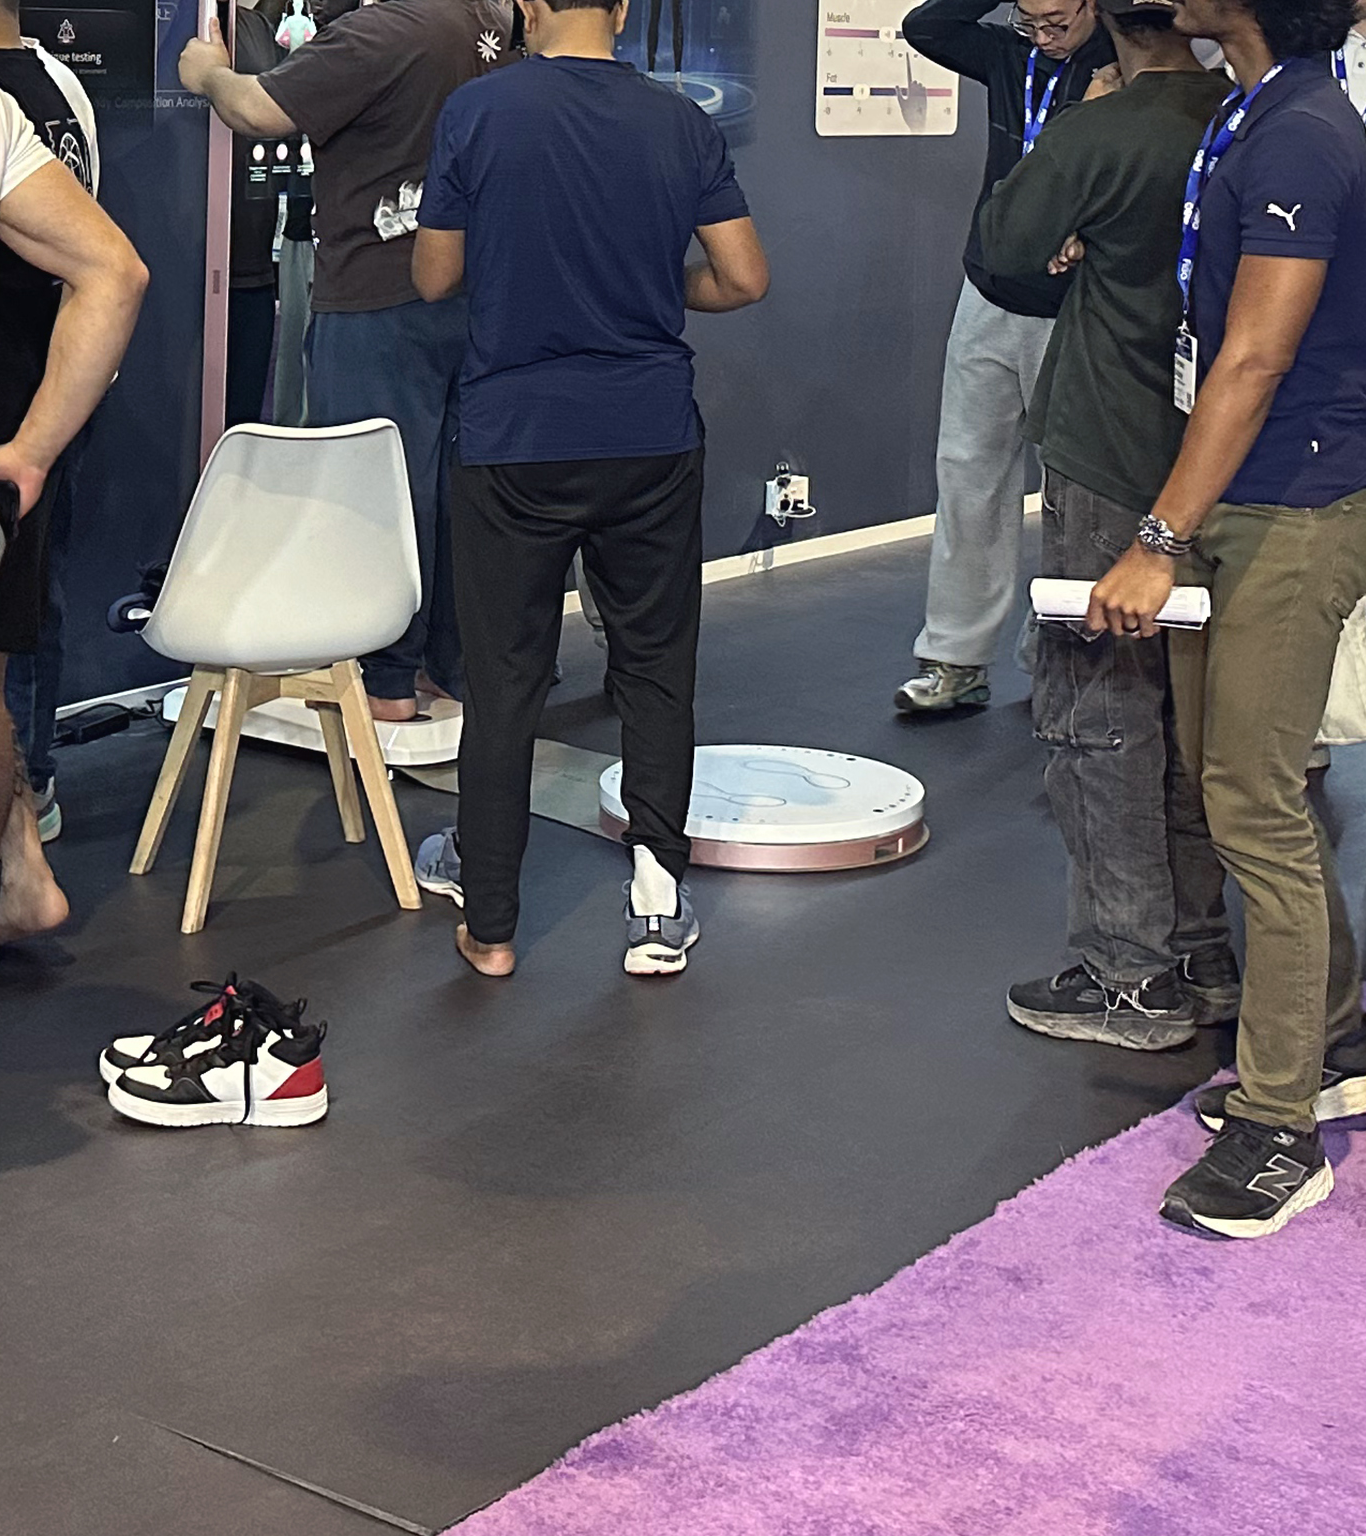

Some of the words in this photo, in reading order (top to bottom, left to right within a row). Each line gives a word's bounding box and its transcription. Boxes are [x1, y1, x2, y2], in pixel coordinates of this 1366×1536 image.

[826, 12, 851, 24] Muscle
[71, 52, 102, 65] testing
[826, 72, 838, 83] Fat
